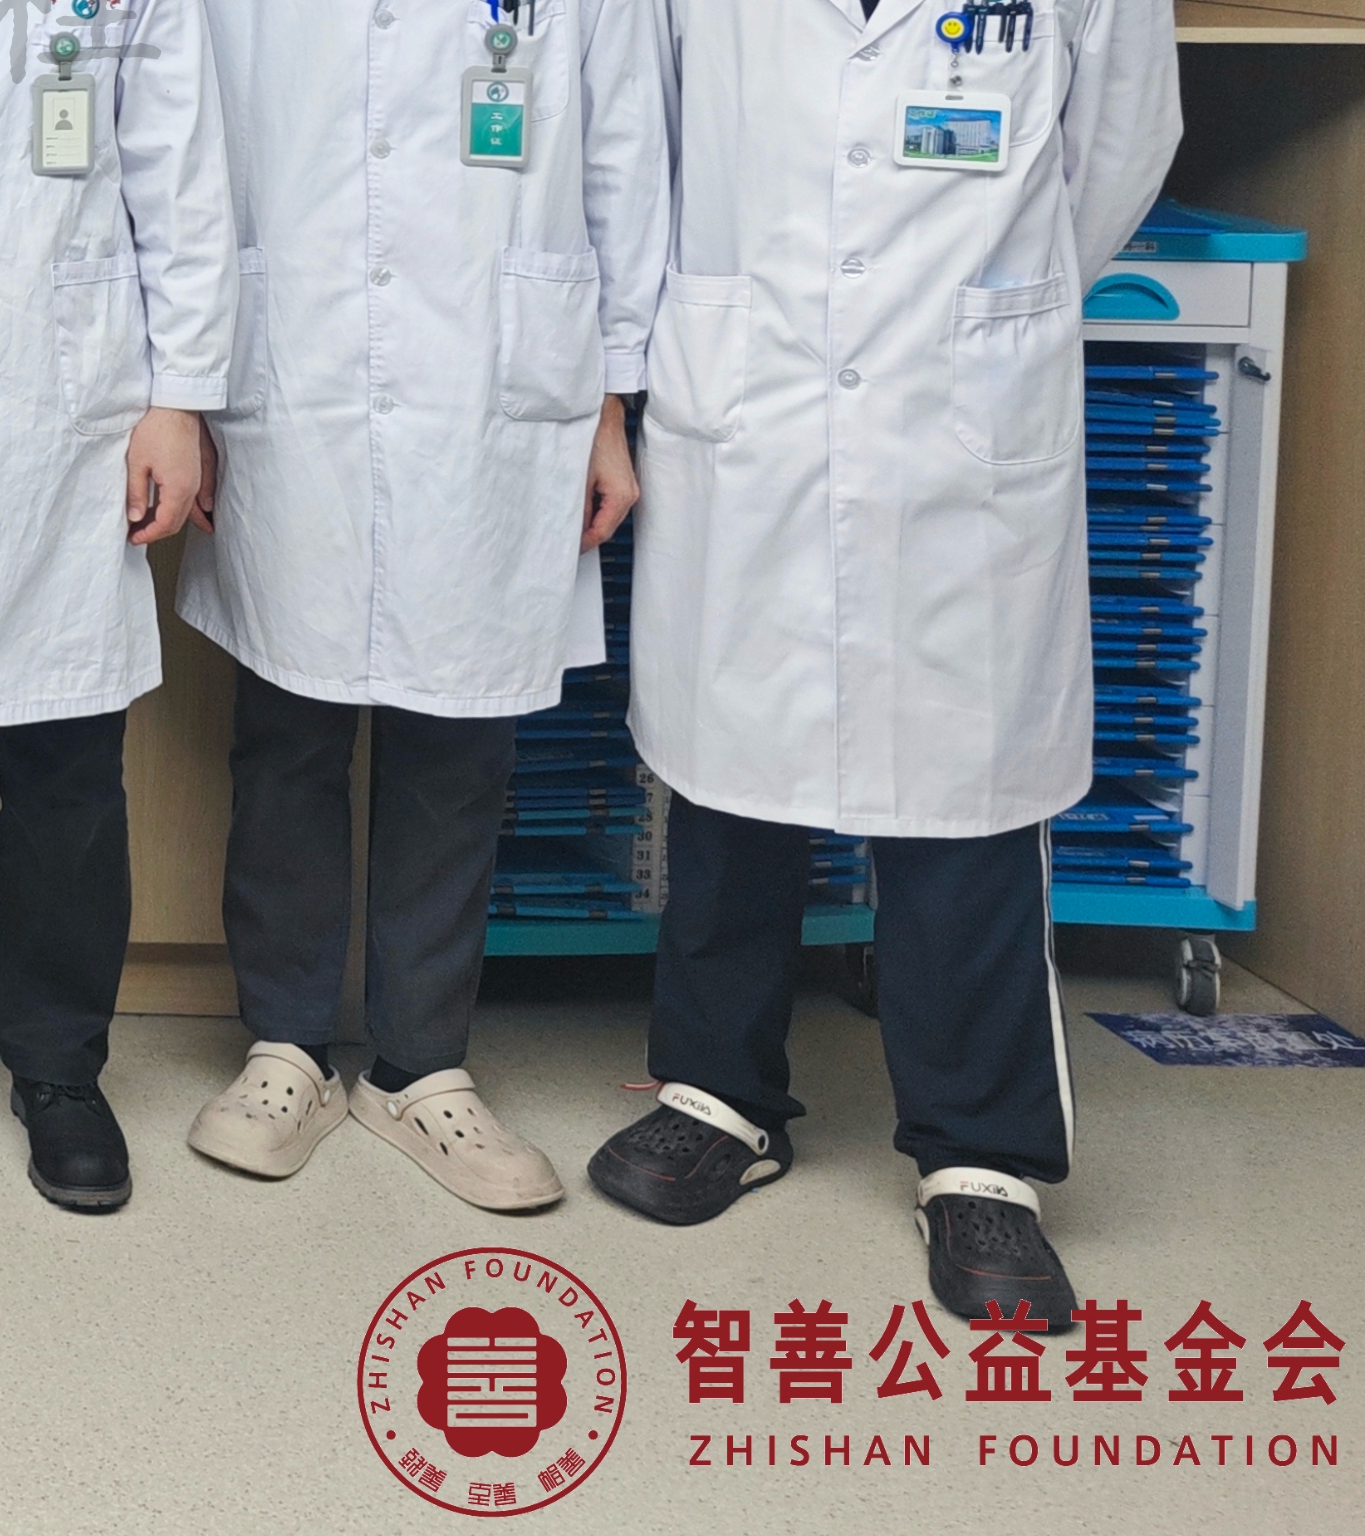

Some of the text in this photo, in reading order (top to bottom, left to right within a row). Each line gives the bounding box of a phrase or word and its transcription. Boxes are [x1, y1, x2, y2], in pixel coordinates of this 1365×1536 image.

[639, 773, 654, 784] 26
[636, 850, 651, 861] 31
[635, 869, 651, 880] 33
